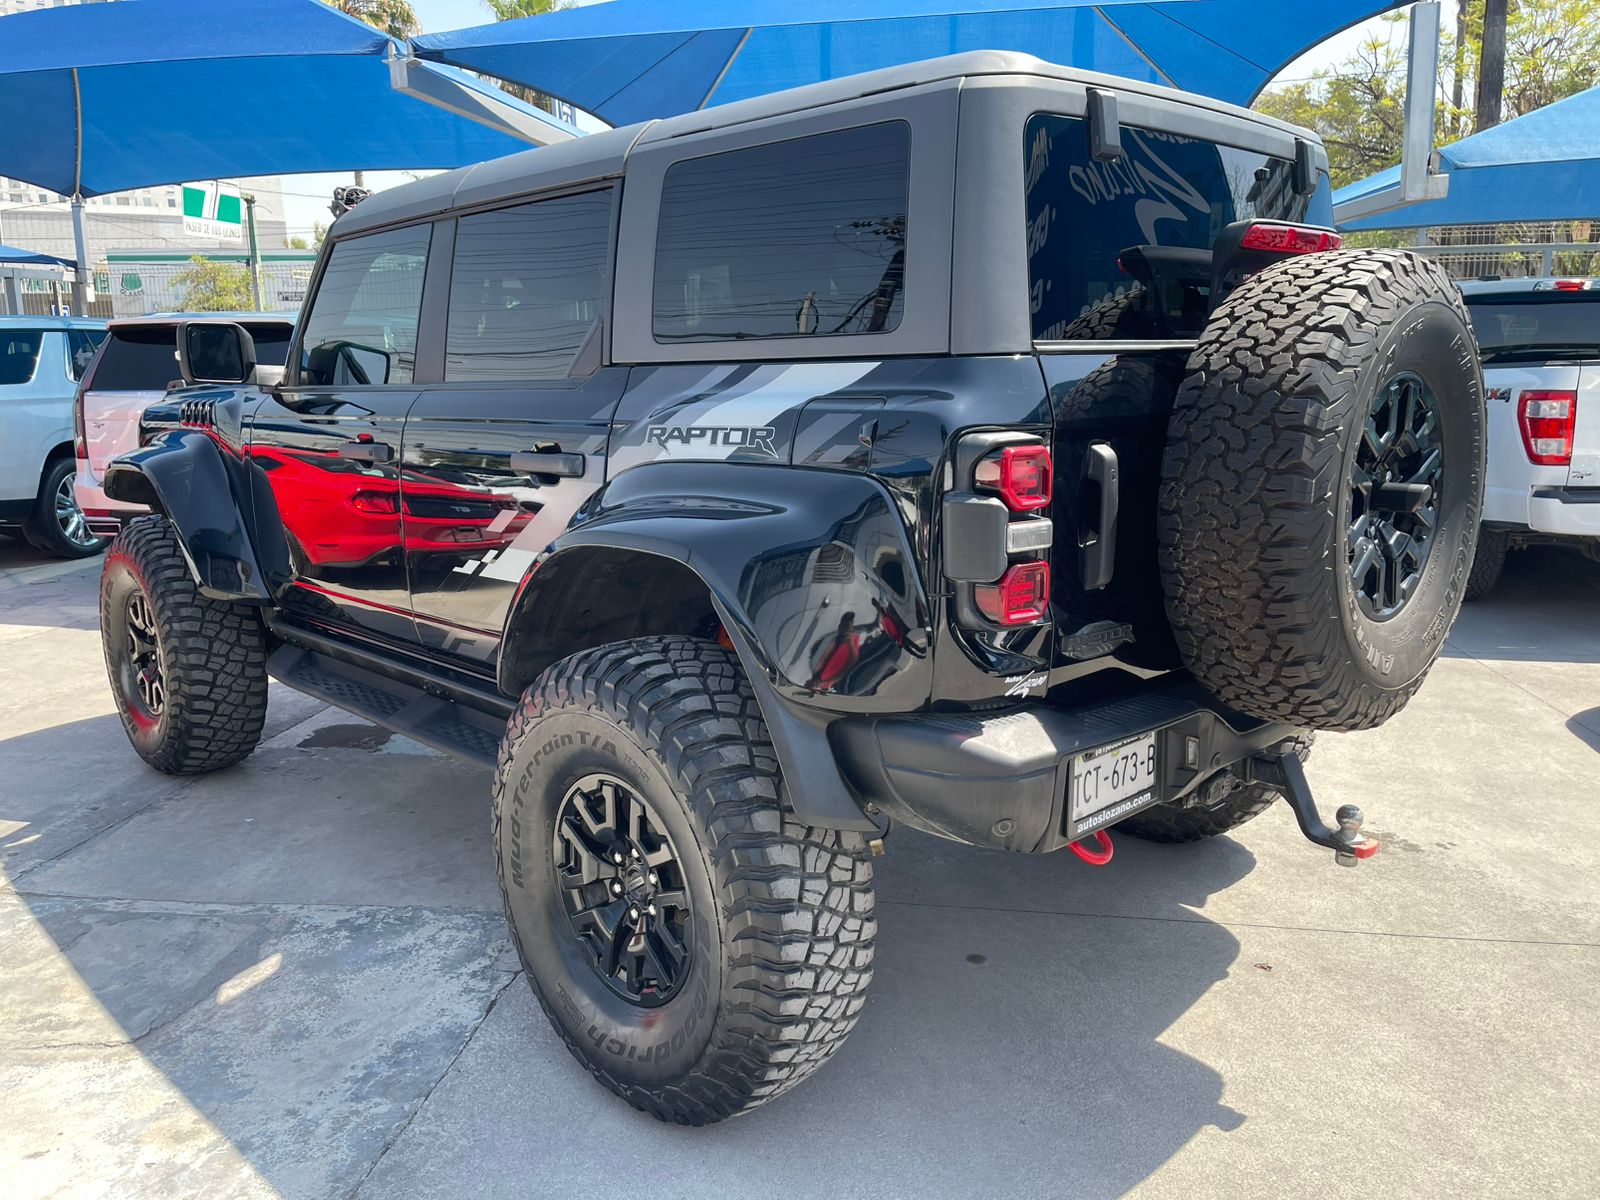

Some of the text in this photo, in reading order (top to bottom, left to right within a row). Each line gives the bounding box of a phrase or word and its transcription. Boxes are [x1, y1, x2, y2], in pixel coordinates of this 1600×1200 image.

[647, 425, 779, 459] RAPTOR
[1074, 744, 1155, 808] TCT-673-B
[510, 733, 573, 890] Mud-Terrain
[1077, 792, 1151, 833] autoslozano.com
